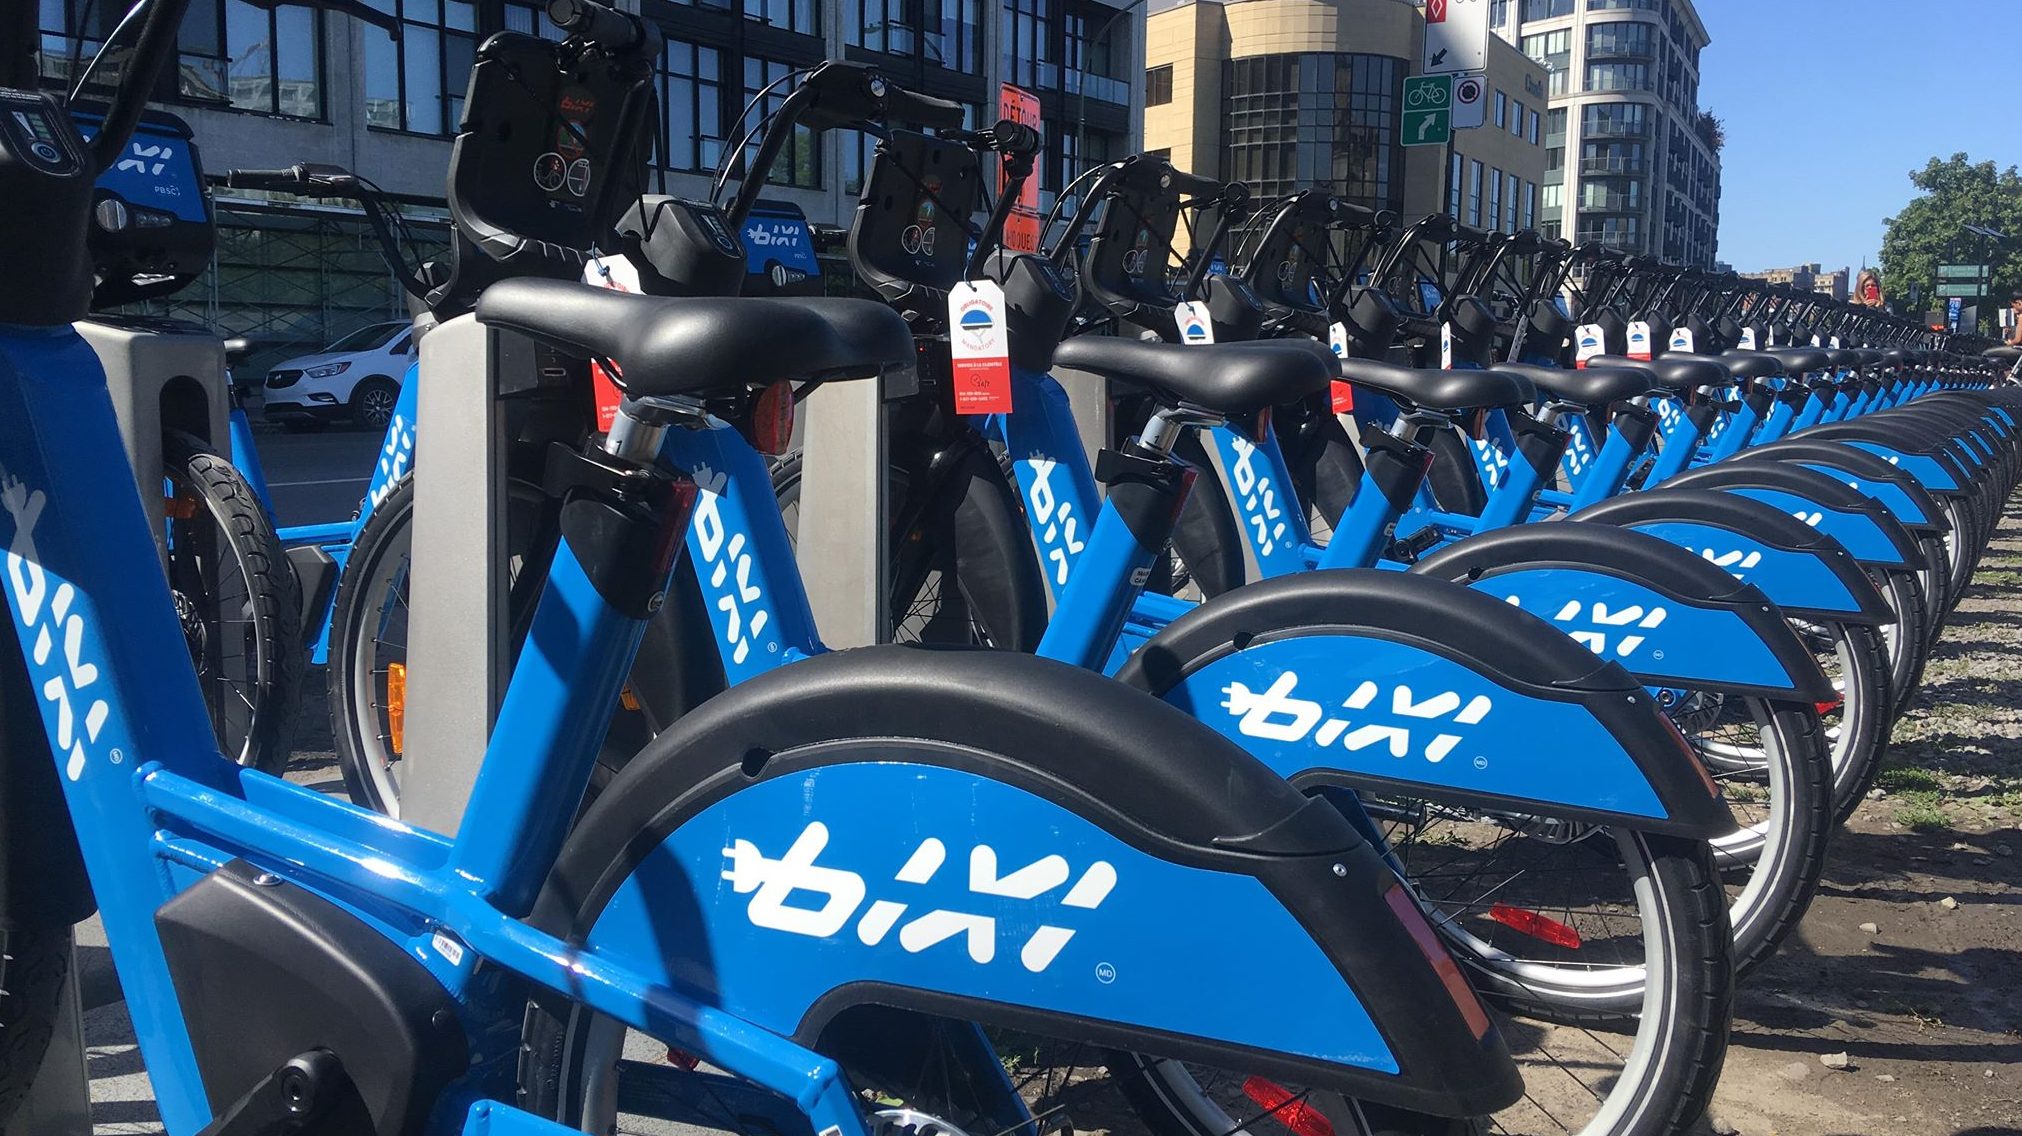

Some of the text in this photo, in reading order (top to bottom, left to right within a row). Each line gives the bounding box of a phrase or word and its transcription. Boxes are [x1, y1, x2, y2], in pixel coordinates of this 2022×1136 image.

[1003, 99, 1038, 130] DÉTOUR
[747, 224, 799, 247] bixi
[691, 461, 768, 665] bixi
[1027, 448, 1085, 585] bix
[0, 473, 109, 782] bixi
[1220, 670, 1492, 763] bixi
[721, 821, 1117, 973] bixi
